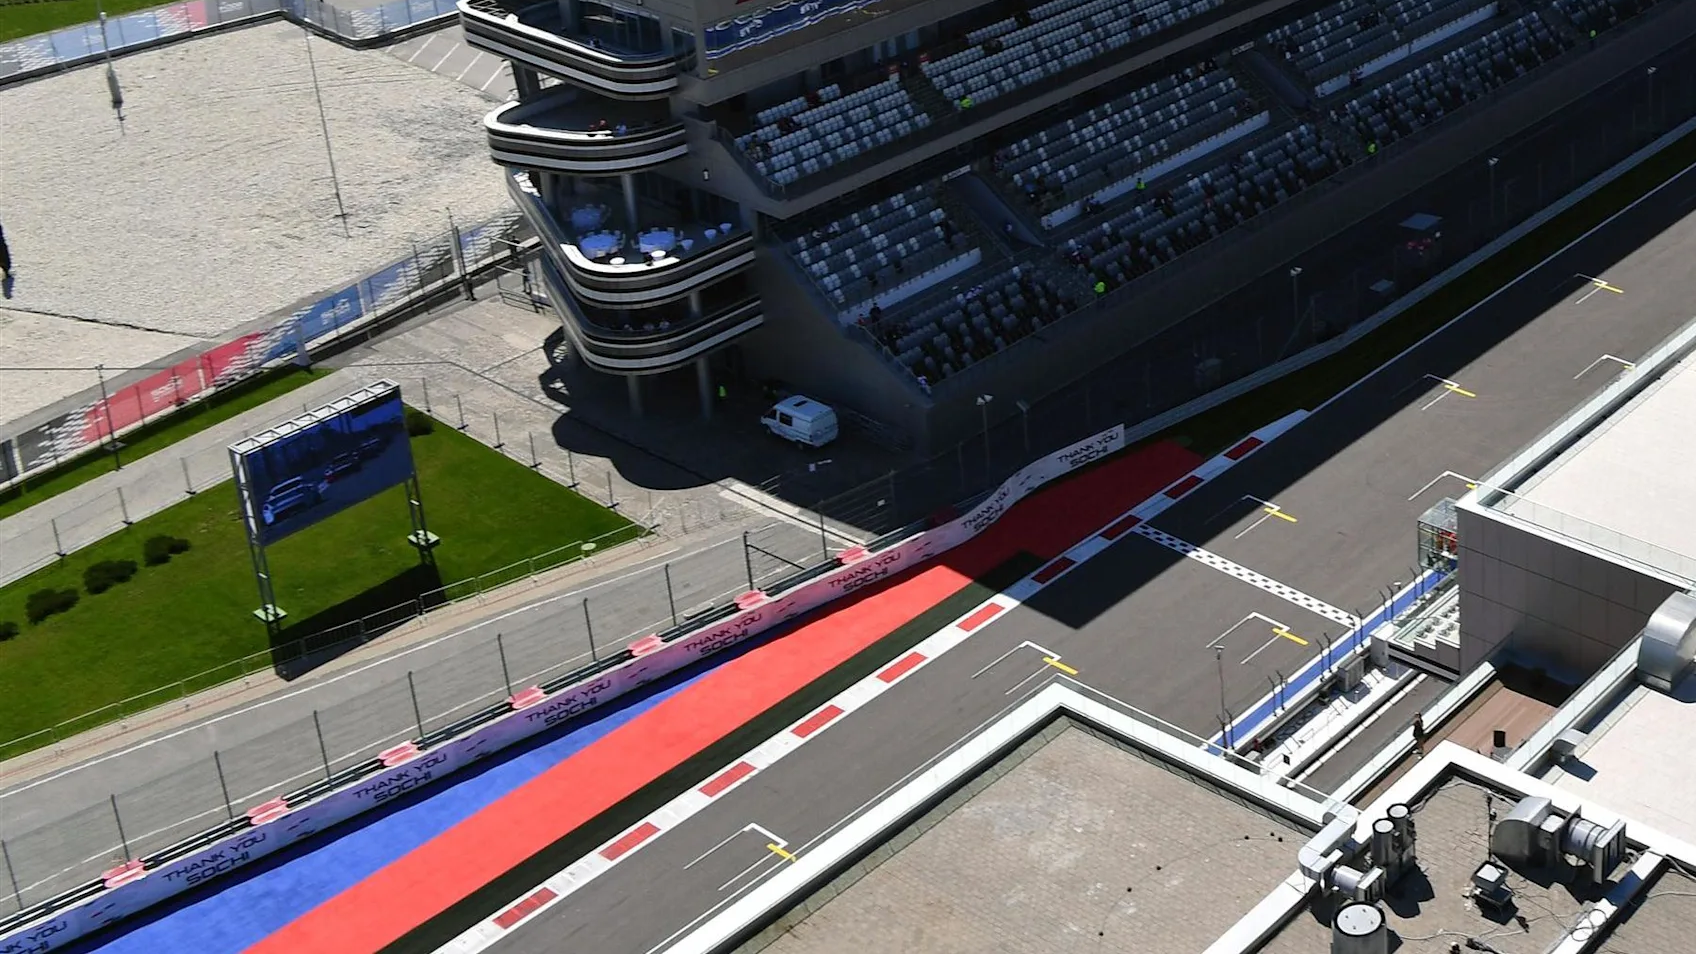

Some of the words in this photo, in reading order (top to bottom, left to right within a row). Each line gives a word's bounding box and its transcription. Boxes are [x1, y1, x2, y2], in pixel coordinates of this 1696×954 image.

[1056, 441, 1095, 463] THANK
[1097, 430, 1120, 446] YOU
[1069, 445, 1109, 467] SOCHI
[961, 500, 995, 529] THANK
[993, 487, 1011, 504] YOU
[973, 504, 1005, 533] SOCHI
[828, 563, 873, 588] THANK
[874, 551, 901, 569] YOU
[843, 567, 888, 592] SOCHI
[683, 629, 733, 652] THANK
[734, 613, 762, 630] YOU
[699, 629, 749, 656] SOCHI
[525, 695, 578, 723] THANK
[581, 679, 612, 698] YOU
[544, 697, 598, 727] SOCHI
[352, 770, 410, 799] THANK
[414, 752, 448, 772] YOU
[373, 771, 431, 803] SOCHI
[162, 850, 225, 882] THANK
[229, 832, 266, 853] YOU
[186, 851, 249, 886] SOCHI
[27, 920, 68, 942] YOU
